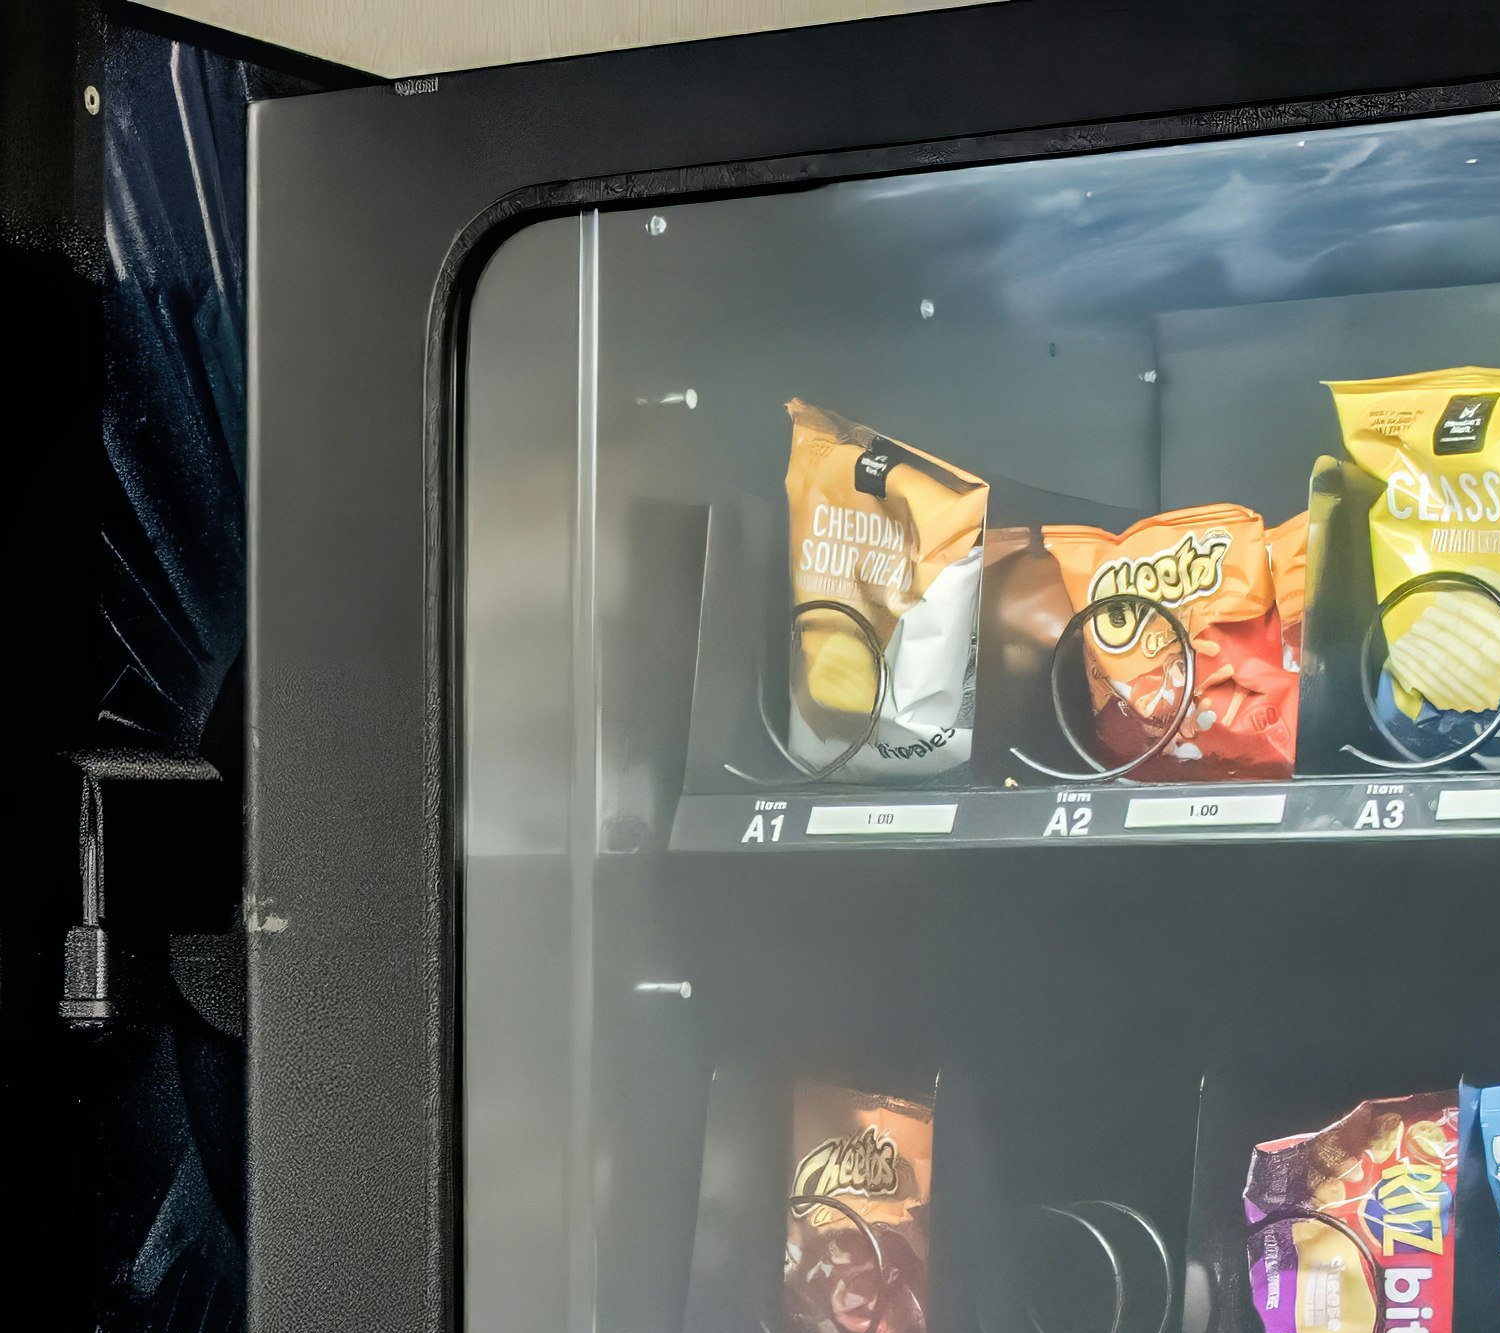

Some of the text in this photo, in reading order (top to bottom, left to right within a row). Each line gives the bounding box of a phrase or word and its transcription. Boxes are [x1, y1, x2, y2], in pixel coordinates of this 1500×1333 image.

[800, 538, 859, 579] SOUR
[742, 815, 785, 843] A1
[1044, 803, 1219, 836] A2 1.00
[1353, 799, 1406, 829] A3
[1382, 1164, 1444, 1257] RITZ
